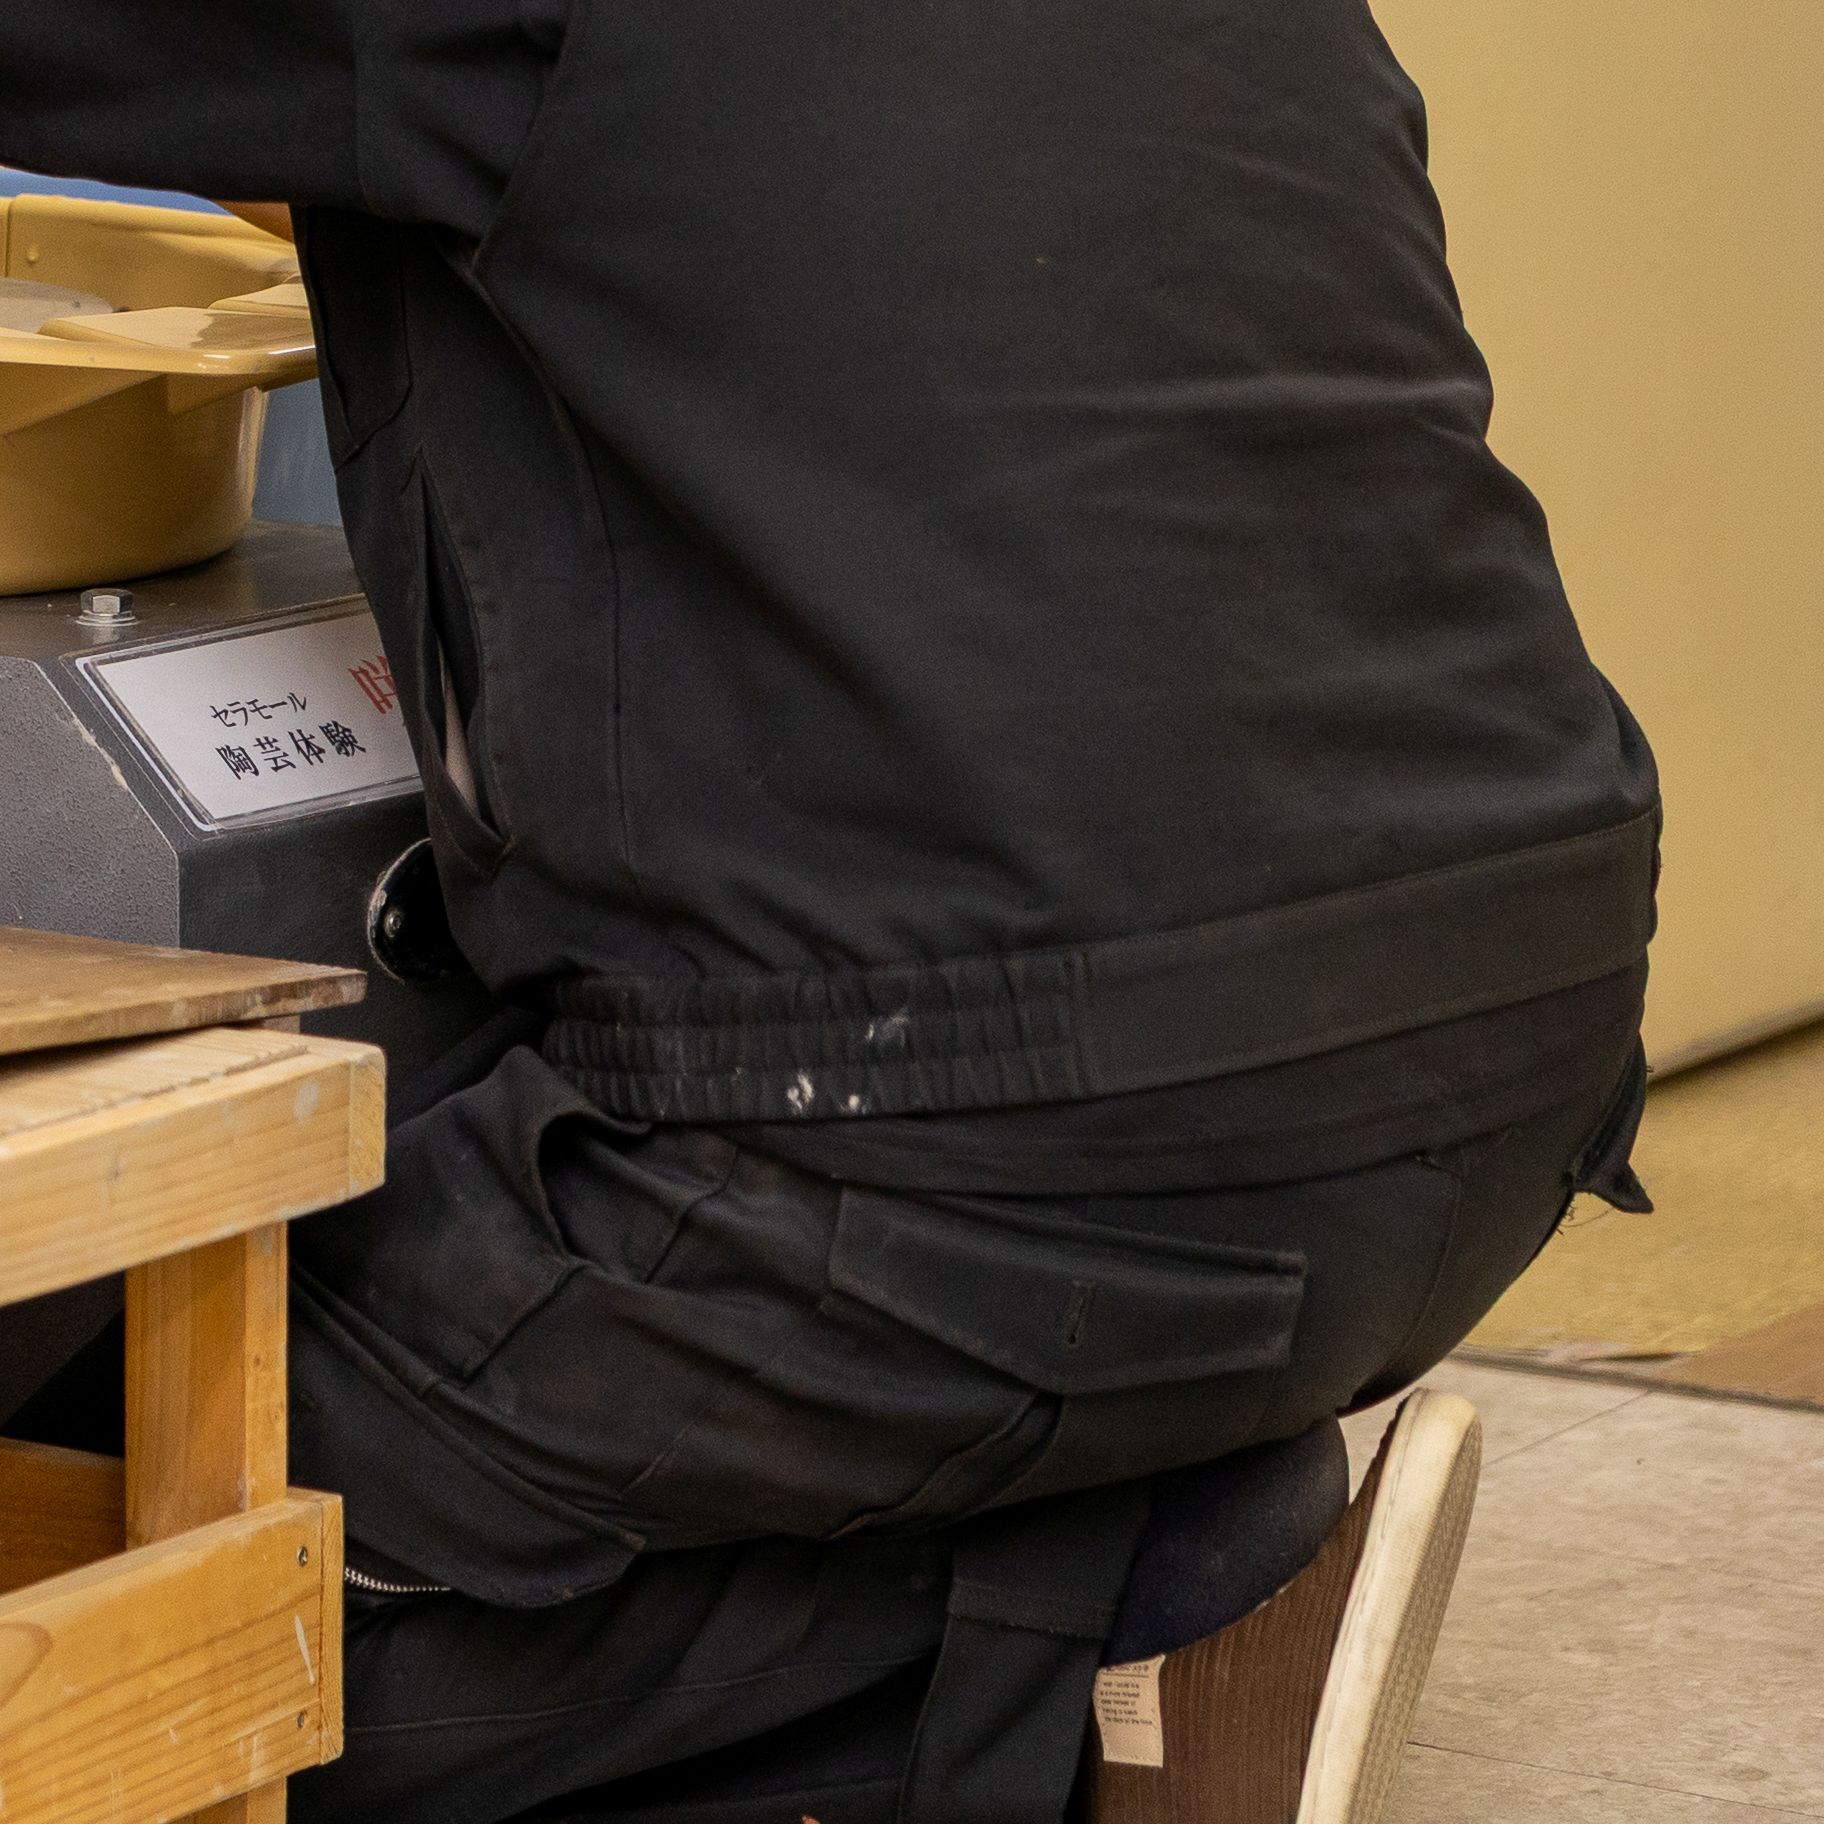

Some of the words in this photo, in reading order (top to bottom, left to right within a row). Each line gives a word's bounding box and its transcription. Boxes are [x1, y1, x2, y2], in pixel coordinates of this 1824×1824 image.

[210, 692, 307, 727] セラモール
[215, 720, 366, 780] 陶芸体験
